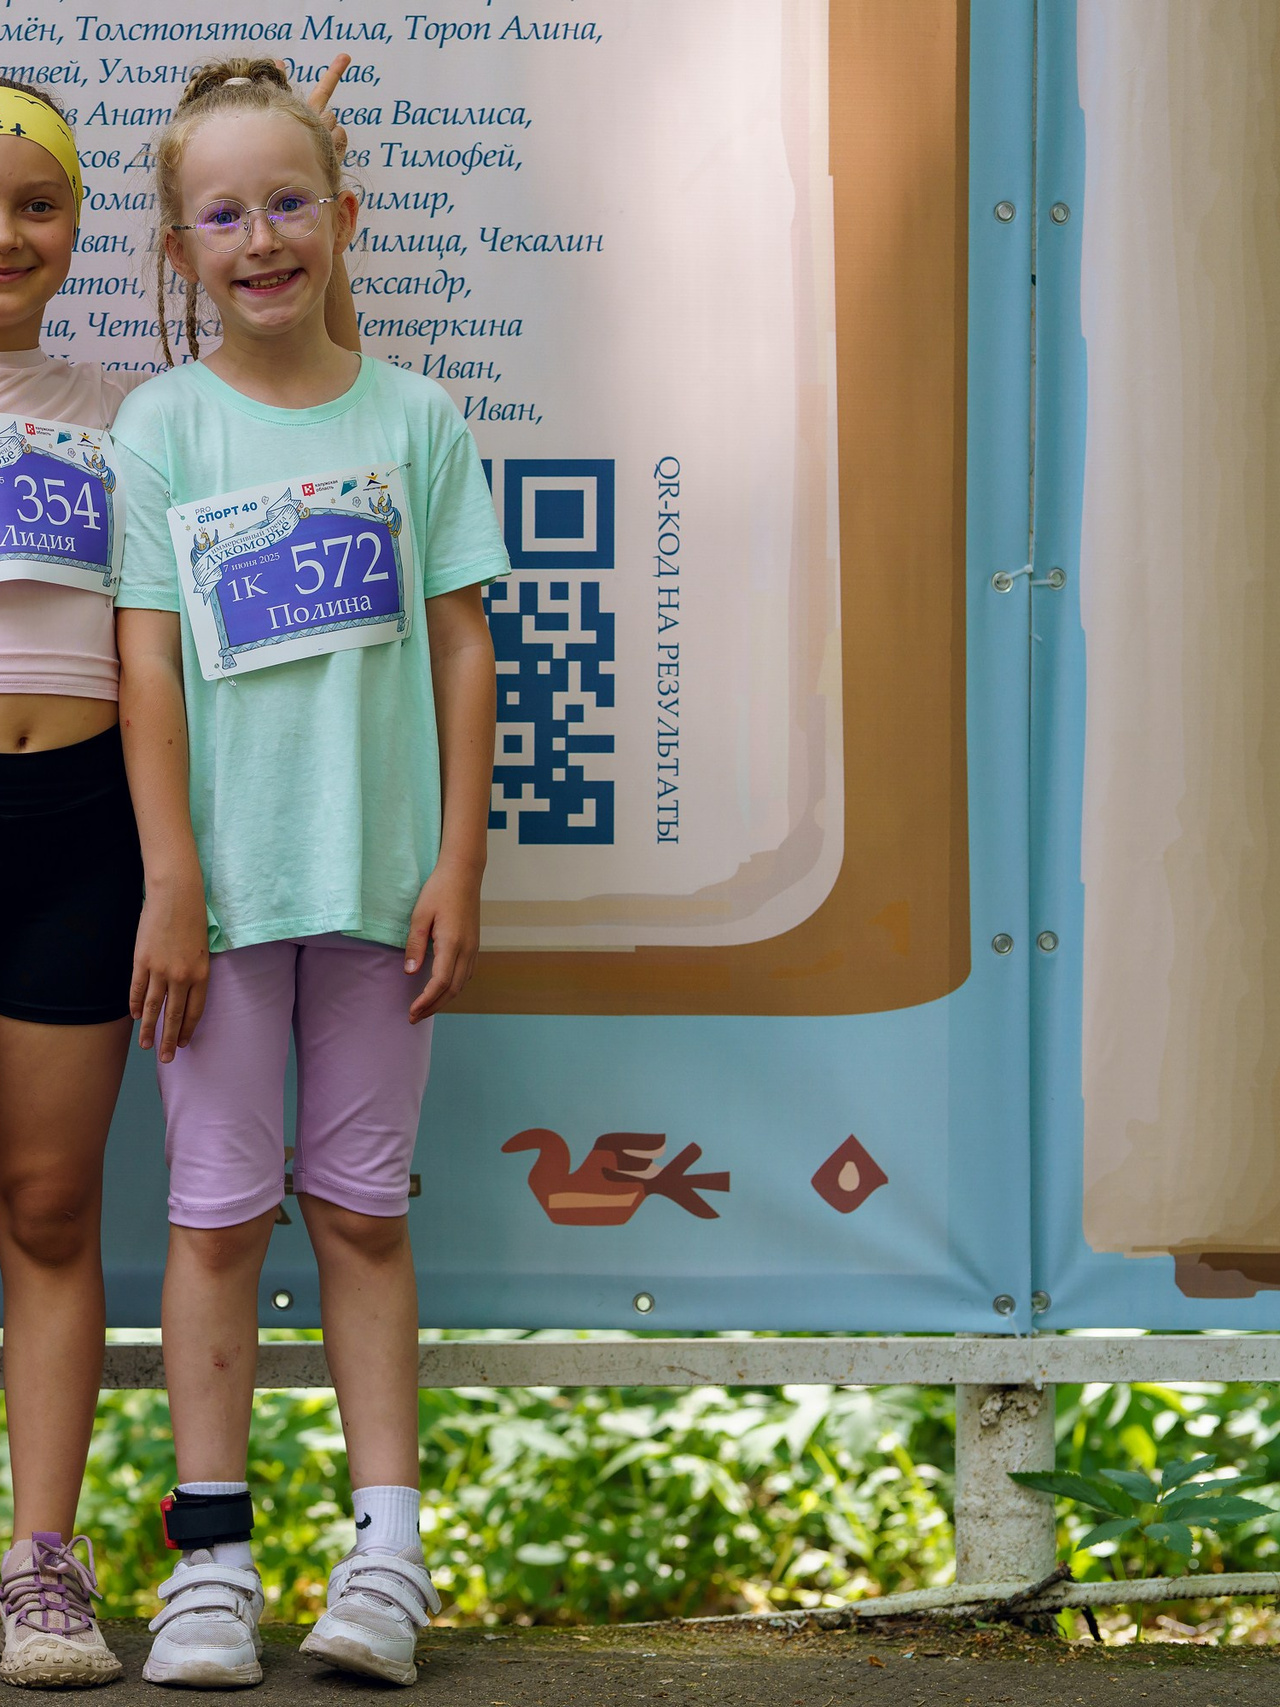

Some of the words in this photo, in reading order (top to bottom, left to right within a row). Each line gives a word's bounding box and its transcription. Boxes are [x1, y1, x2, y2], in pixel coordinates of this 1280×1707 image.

[75, 15, 293, 42] Толстопятова
[299, 14, 393, 45] Мила,
[404, 14, 492, 50] Тороп
[497, 14, 603, 44] Алина,
[390, 99, 533, 130] Василиса,
[380, 141, 523, 176] Тимофей,
[479, 226, 604, 254] Чекалин
[350, 268, 472, 304] ександр,
[421, 353, 502, 383] Иван,
[463, 395, 544, 425] Иван,
[14, 474, 101, 531] 354
[194, 506, 211, 515] PRO
[197, 505, 239, 524] СПОРТ
[241, 502, 258, 512] 40
[653, 455, 681, 578] QR-КОД
[205, 520, 291, 570] Лукоморье
[223, 564, 229, 573] 7
[231, 559, 258, 571] июня
[259, 552, 280, 564] 2025
[290, 531, 389, 595] 572
[266, 594, 373, 630] Полина
[657, 585, 680, 635] НА
[656, 642, 680, 845] РЕЗУЛЬТАТЫ
